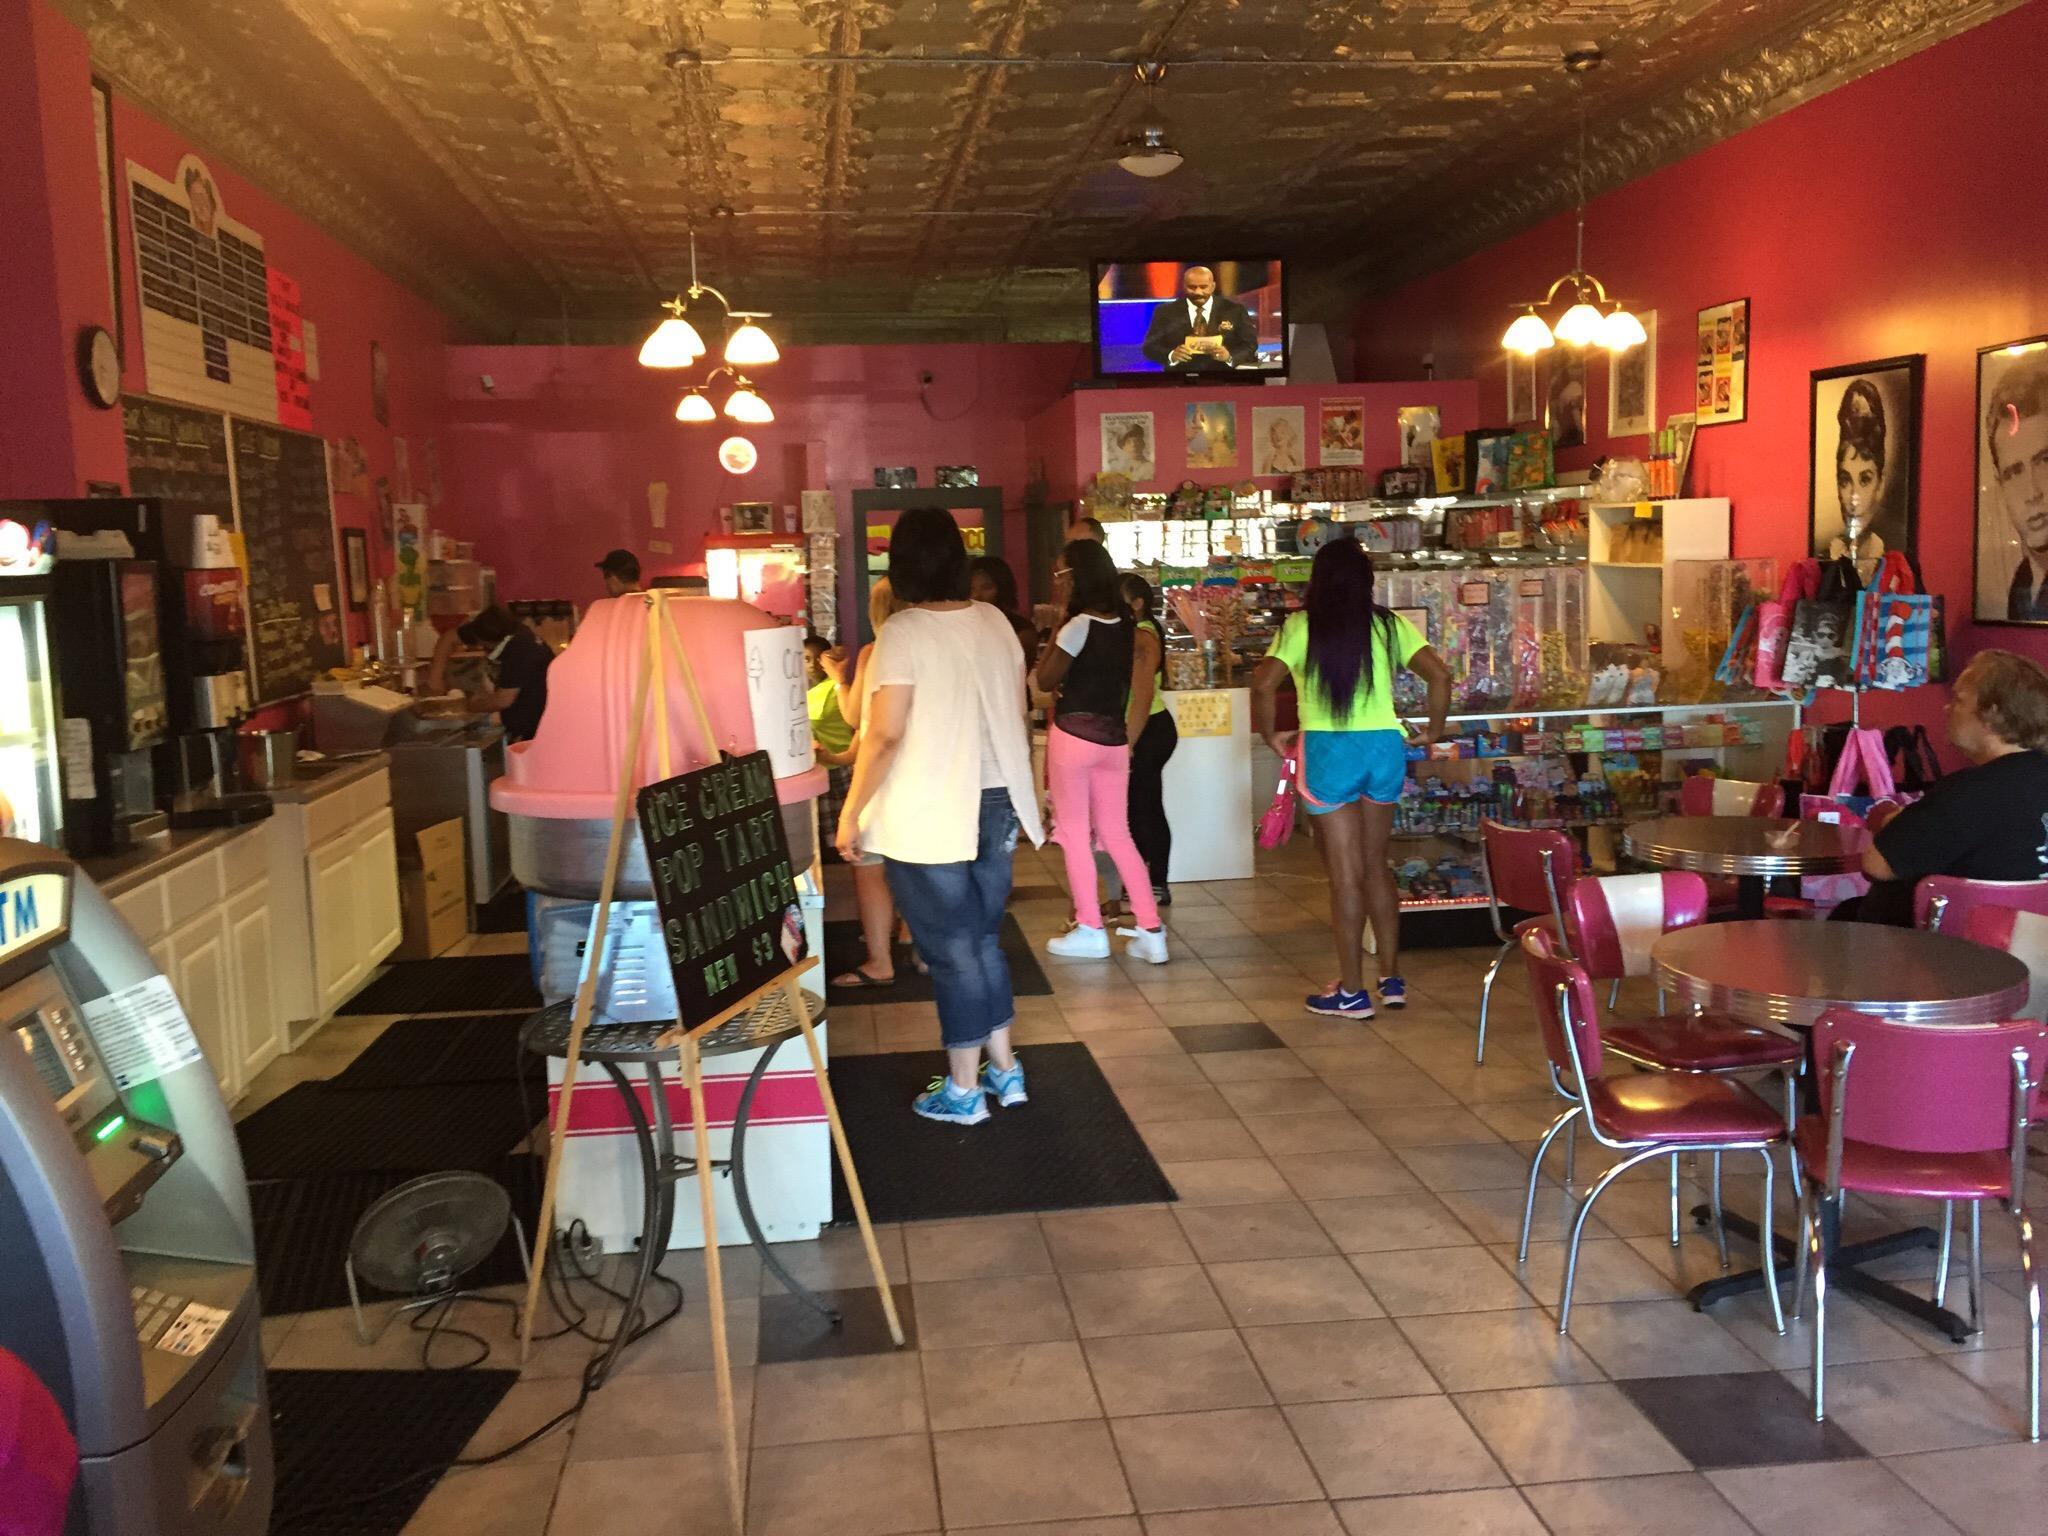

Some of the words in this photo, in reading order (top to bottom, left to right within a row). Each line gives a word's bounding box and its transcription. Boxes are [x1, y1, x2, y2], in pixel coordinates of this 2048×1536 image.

[647, 783, 693, 843] ICE
[698, 758, 775, 820] CREAM
[656, 842, 704, 904] POP
[715, 809, 779, 873] TART
[664, 861, 794, 965] SANDWICH
[702, 953, 741, 997] NEW
